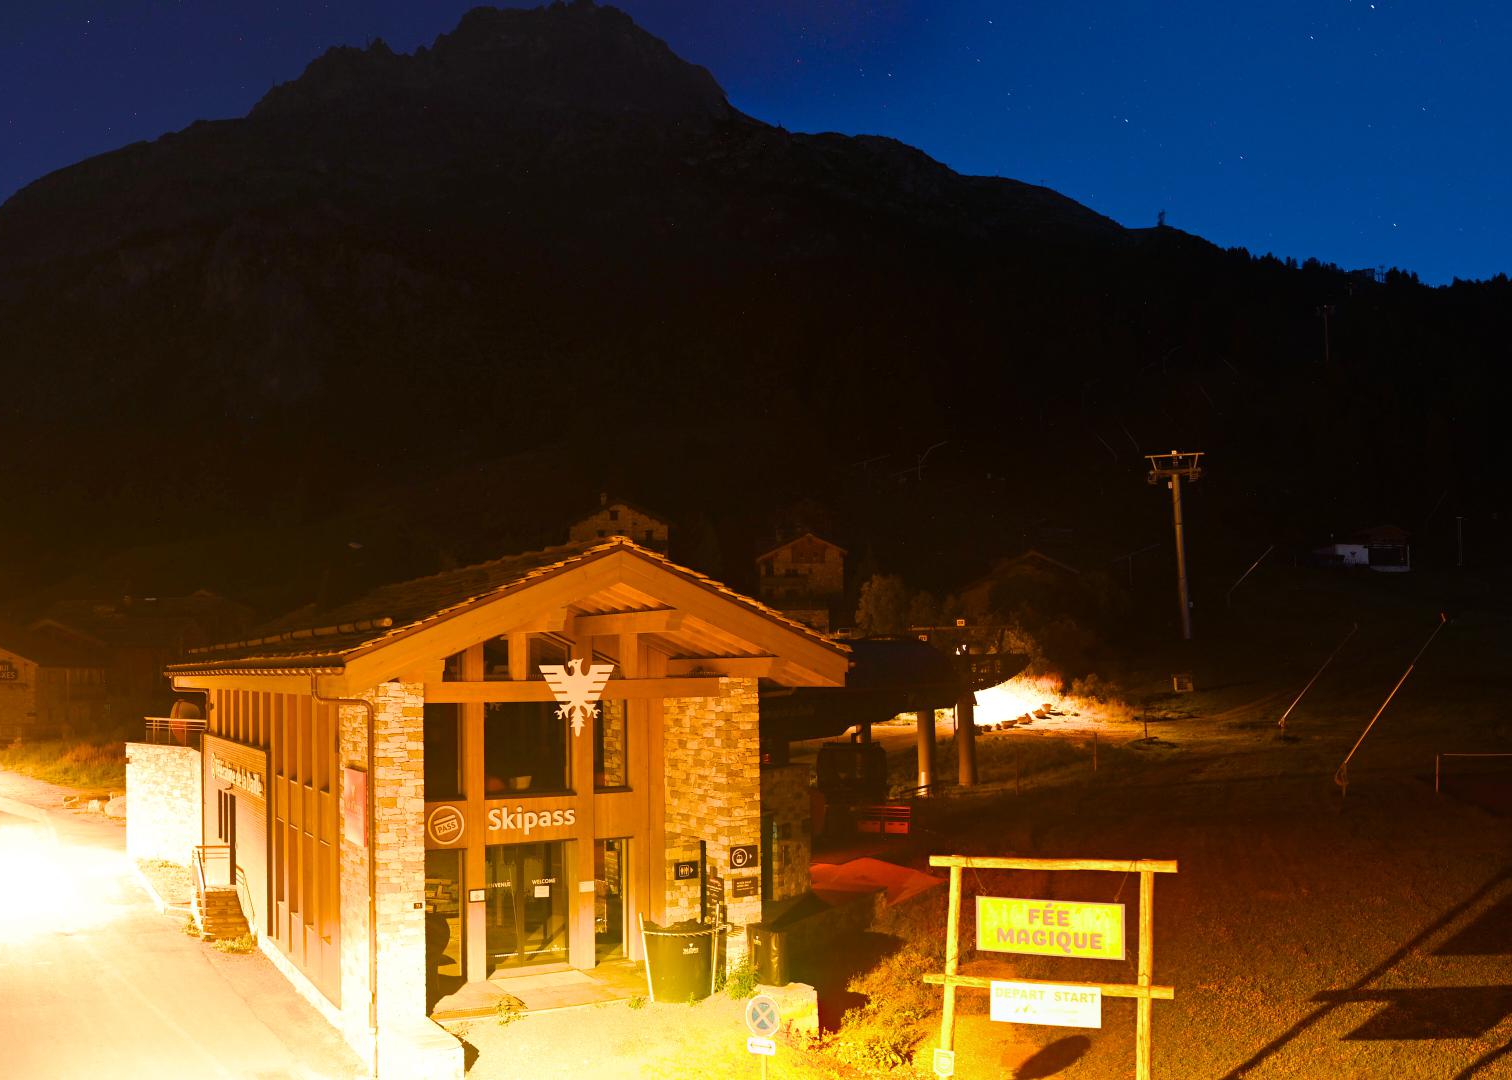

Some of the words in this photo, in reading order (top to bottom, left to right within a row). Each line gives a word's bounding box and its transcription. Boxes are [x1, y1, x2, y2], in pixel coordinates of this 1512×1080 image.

[437, 821, 456, 834] PASS
[488, 806, 576, 836] Skipass
[1028, 903, 1070, 927] FÉE
[996, 927, 1102, 954] MAGIQUE
[1054, 991, 1097, 1004] START
